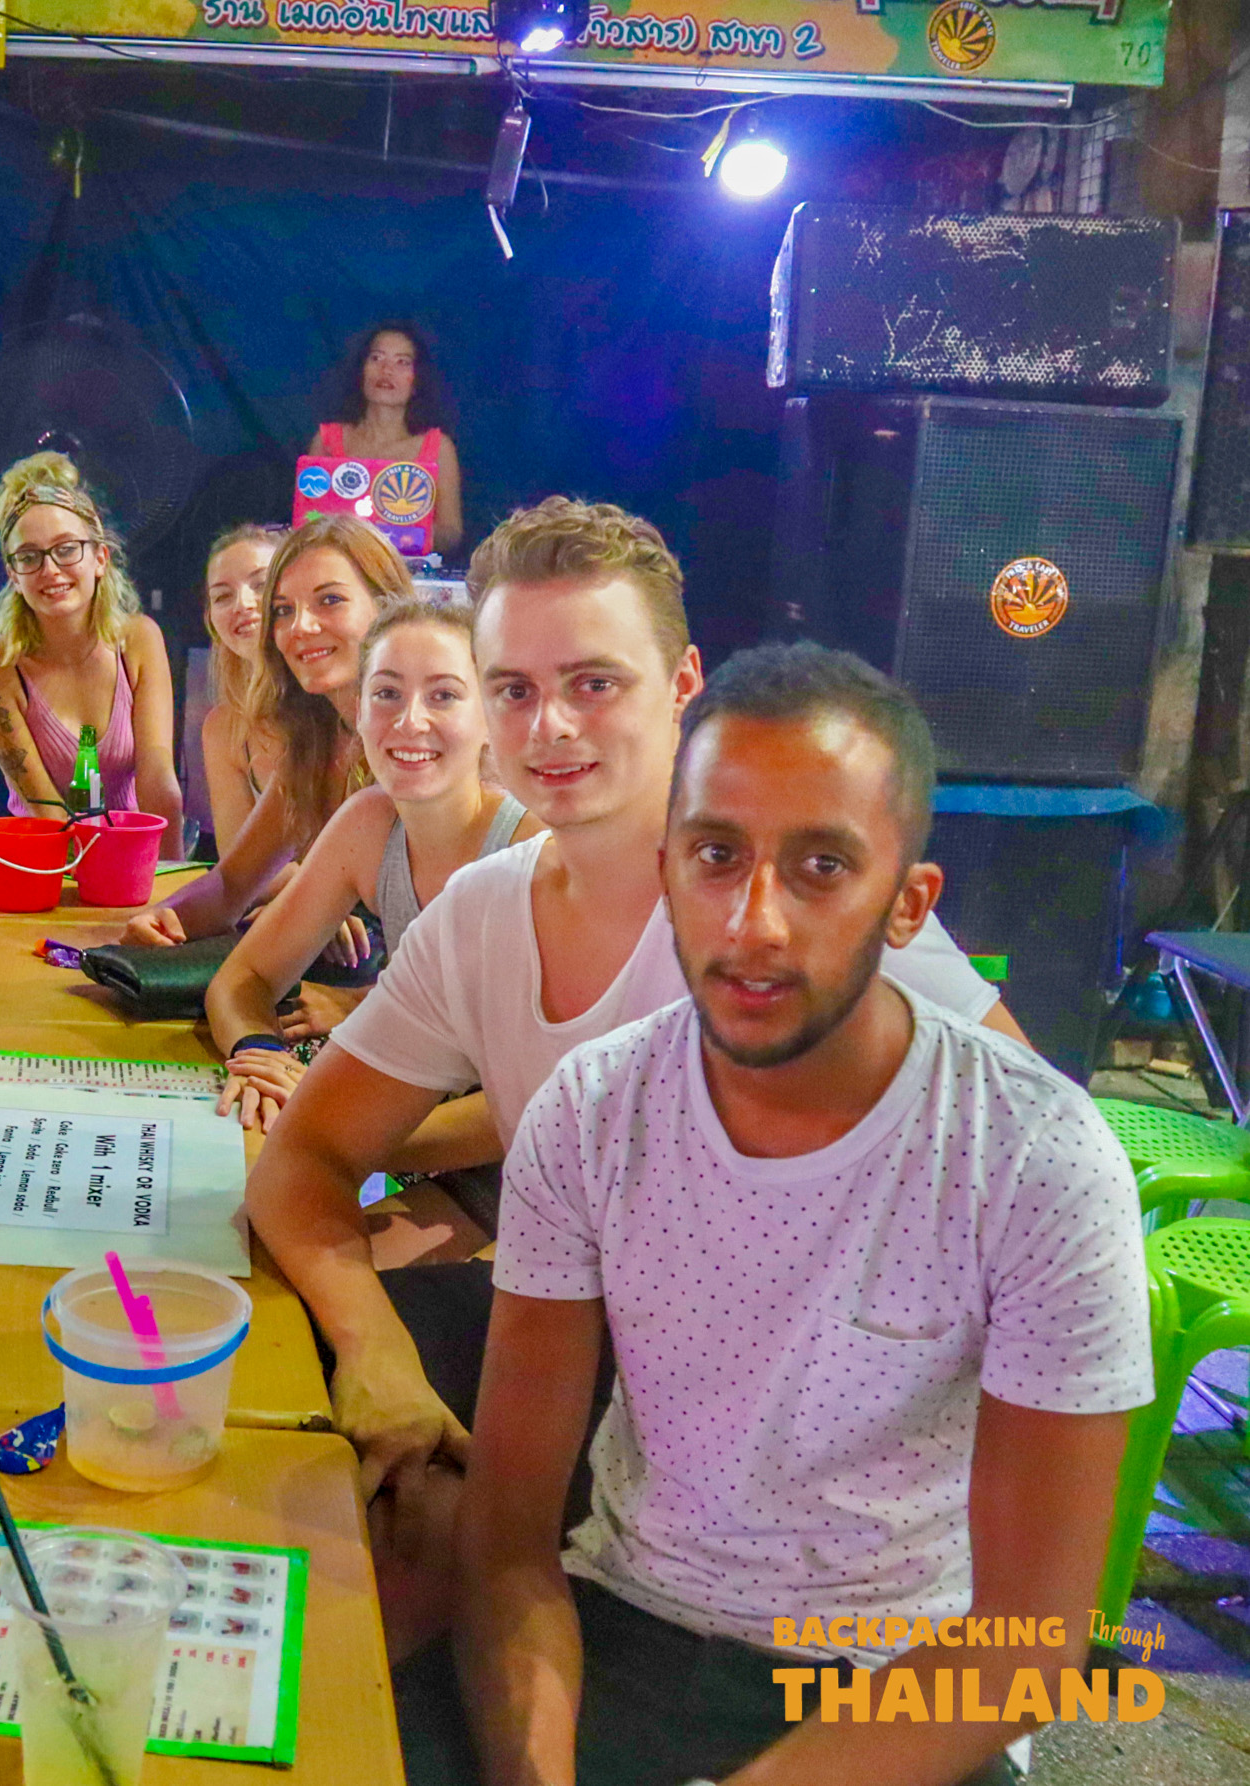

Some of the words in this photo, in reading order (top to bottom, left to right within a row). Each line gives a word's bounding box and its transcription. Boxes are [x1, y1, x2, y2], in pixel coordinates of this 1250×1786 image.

[708, 18, 785, 54] สาขา
[792, 21, 824, 57] 2
[1121, 41, 1151, 67] 70
[1008, 619, 1050, 634] TRAVELER
[2, 1125, 18, 1142] Fanta
[30, 1118, 47, 1135] Sprite
[58, 1120, 74, 1136] Coke
[140, 1123, 157, 1140] THAI
[25, 1144, 41, 1160] Soda
[94, 1135, 116, 1157] With
[138, 1141, 156, 1173] WHISKY
[50, 1160, 63, 1175] zero
[17, 1169, 36, 1193] Lemon
[136, 1176, 154, 1189] OR
[43, 1185, 61, 1213] Redbull
[86, 1174, 112, 1208] mixer
[13, 1194, 30, 1211] soda
[133, 1194, 152, 1227] VODKA
